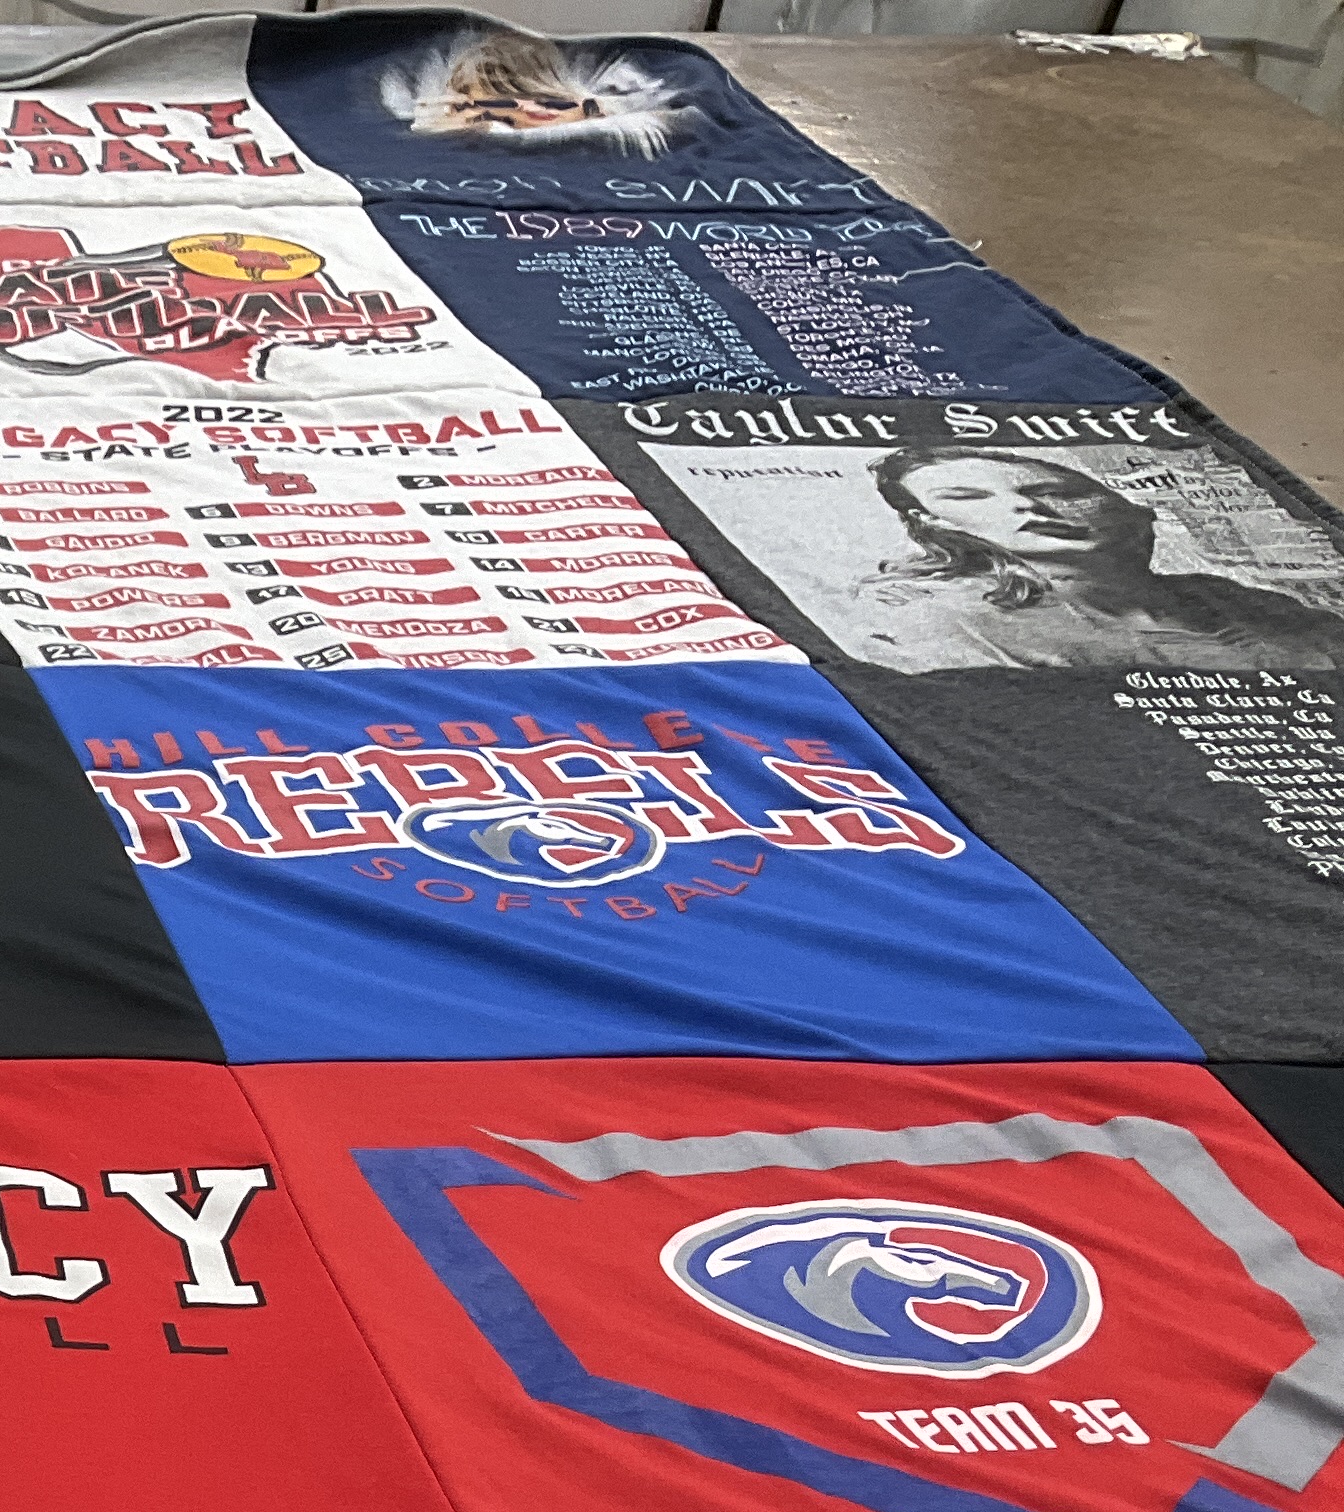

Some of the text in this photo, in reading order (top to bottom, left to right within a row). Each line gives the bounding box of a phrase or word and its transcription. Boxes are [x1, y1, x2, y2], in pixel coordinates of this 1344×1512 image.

[400, 214, 497, 239] THE
[496, 211, 643, 240] 1989
[648, 220, 812, 243] WORLD
[852, 256, 880, 268] CA
[141, 317, 419, 352] PLAOFFS
[345, 340, 454, 356] 2022
[796, 345, 879, 362] OMAHA,
[162, 404, 284, 424] 2022
[618, 398, 1190, 445] Taylor Swift
[203, 408, 562, 444] SOFTBALL
[40, 443, 192, 461] STATE
[412, 467, 601, 488] 2 MOREAUX
[686, 464, 844, 481] reputation
[4, 482, 131, 494] ROBBINS
[18, 508, 149, 521] BALLARD
[265, 503, 375, 517] DOWNS
[434, 496, 633, 515] 7 MITCHELL
[44, 532, 156, 550] GAUDIO
[220, 531, 415, 547] 9 BERGMAN
[455, 524, 646, 543] 10 CARTER
[45, 563, 189, 581] KOLANEK
[234, 557, 417, 575] 13 YOUNG
[478, 554, 674, 572] 14 MORRIS
[5, 588, 206, 611] 15 POWERS
[257, 587, 436, 606] 17 PRATT
[275, 614, 492, 637] 20 MENDOZA
[532, 605, 707, 632] 21 COX
[45, 644, 91, 660] 22
[302, 647, 347, 669] 25
[1125, 671, 1251, 690] Glendale,
[1113, 693, 1198, 708] Santa
[1206, 693, 1292, 709] Clara,
[84, 729, 313, 768] HILL
[91, 740, 966, 869] REBELS
[351, 852, 765, 921] SOFTBALL
[857, 1398, 1151, 1453] TEAM 35
